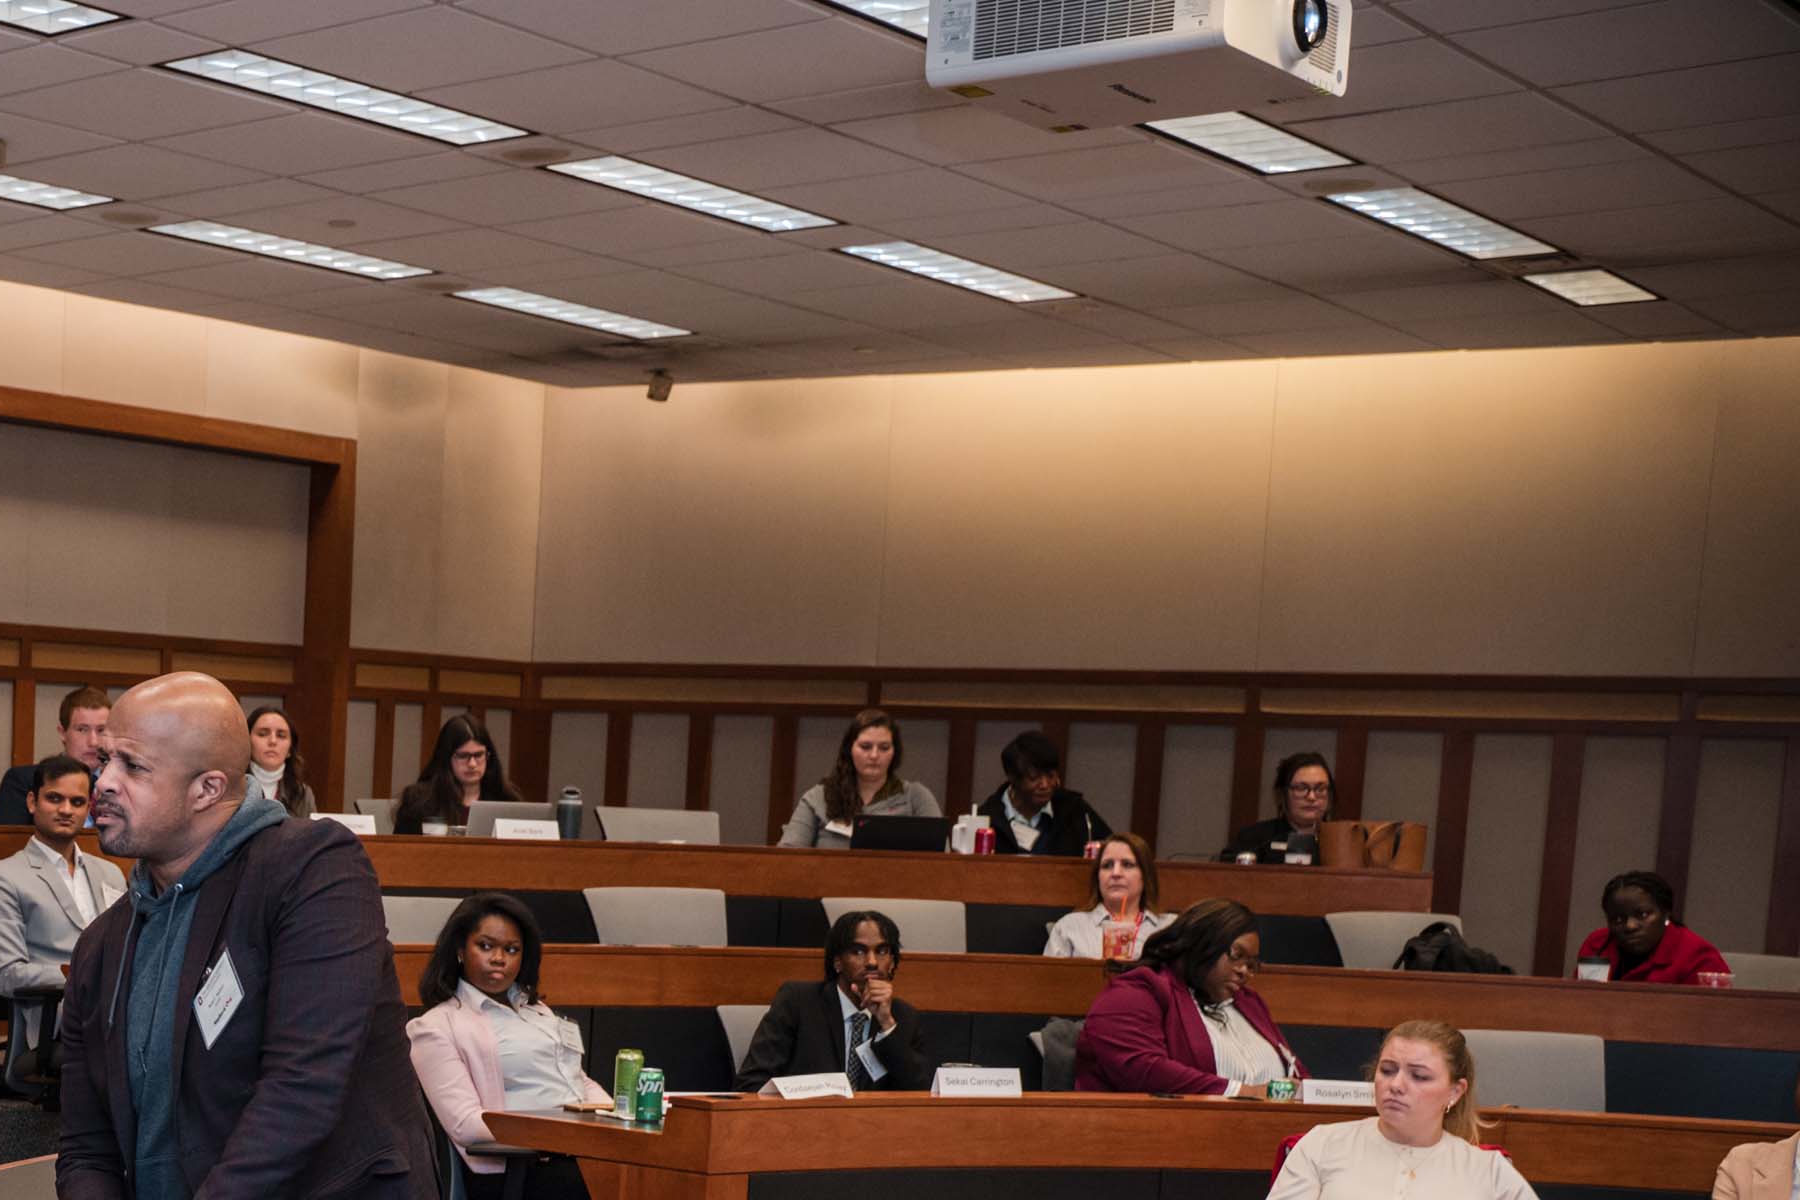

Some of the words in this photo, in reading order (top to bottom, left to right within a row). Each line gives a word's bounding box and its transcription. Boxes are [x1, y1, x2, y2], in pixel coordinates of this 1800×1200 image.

[945, 1077, 969, 1086] Sekai
[970, 1077, 1015, 1088] Carrington
[1315, 1088, 1352, 1099] Rosalyn
